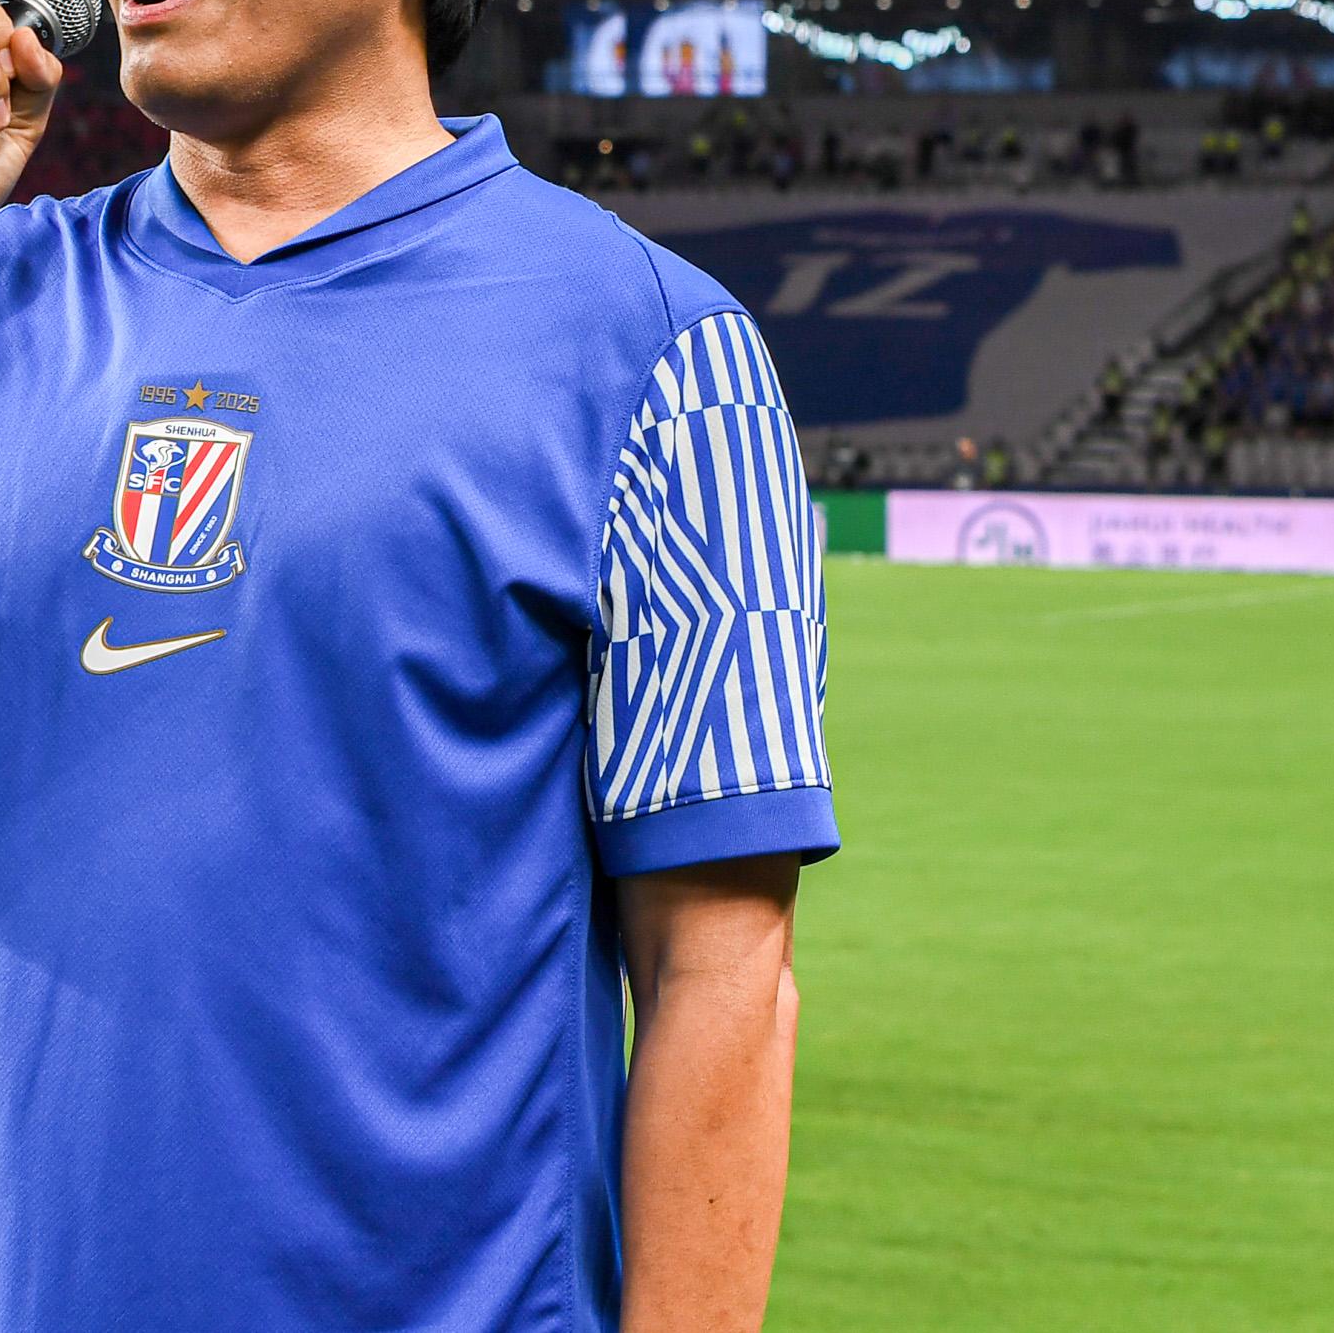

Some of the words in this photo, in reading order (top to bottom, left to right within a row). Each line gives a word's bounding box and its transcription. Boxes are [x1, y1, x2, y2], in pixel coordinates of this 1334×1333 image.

[139, 384, 177, 405] 1995
[216, 391, 261, 414] 2025
[165, 424, 217, 439] SHENHUA
[128, 472, 182, 493] SFC
[189, 530, 208, 556] SINCE
[130, 566, 197, 586] SHANGHAI
